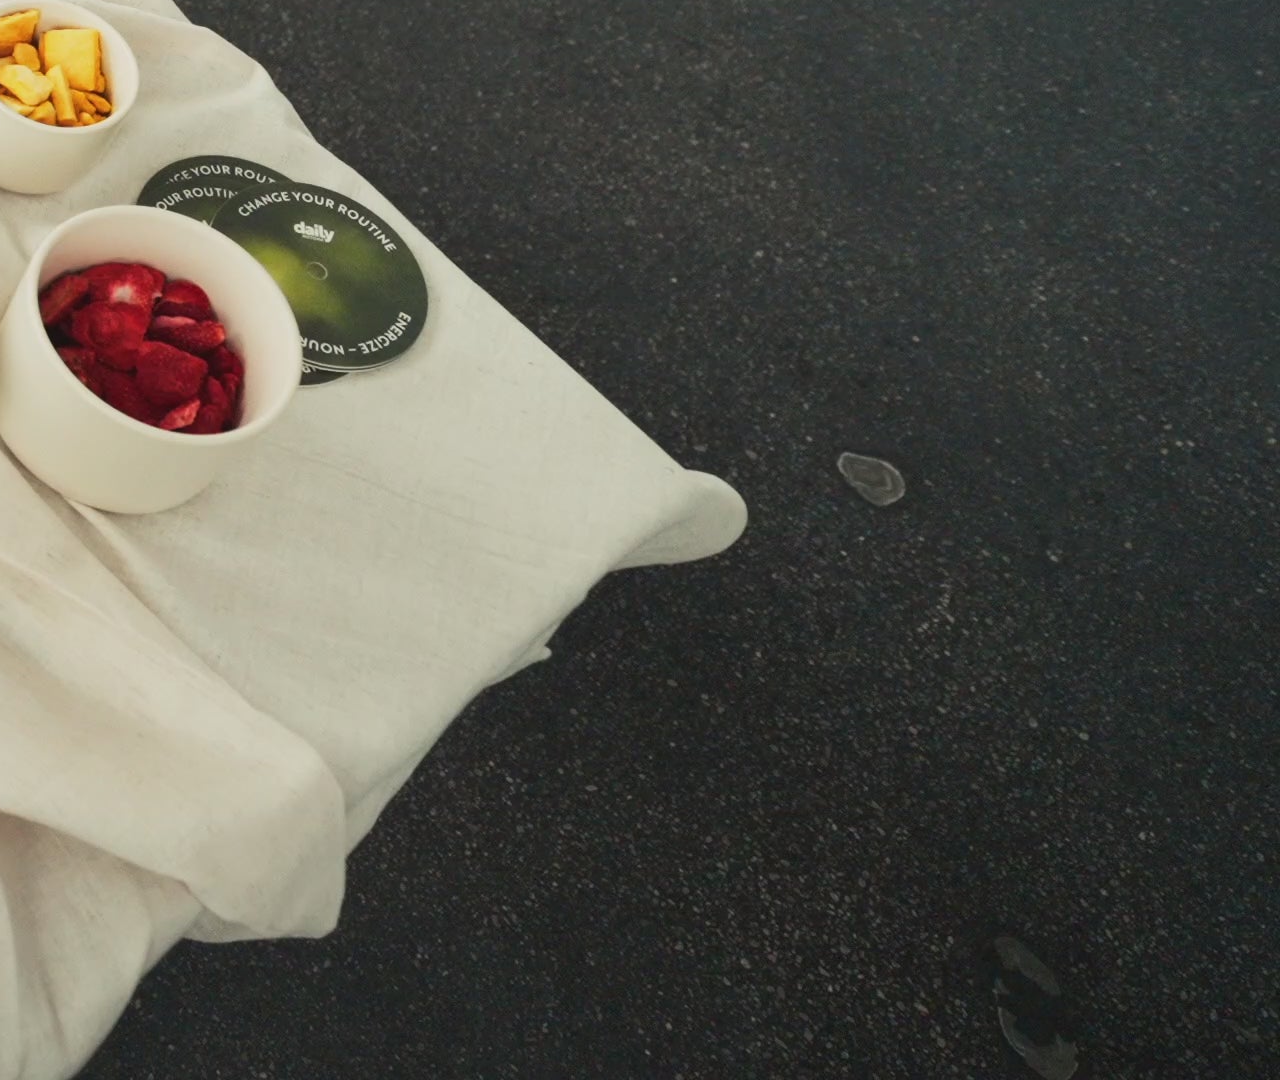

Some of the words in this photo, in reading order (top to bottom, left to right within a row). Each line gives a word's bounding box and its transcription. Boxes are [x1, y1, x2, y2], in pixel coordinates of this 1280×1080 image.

[191, 164, 231, 177] YOUR
[155, 192, 183, 211] OUR
[238, 191, 290, 217] CHANGE
[292, 192, 334, 209] YOUR
[337, 204, 397, 252] ROUTINE
[293, 221, 335, 243] daily
[358, 312, 412, 354] ENERGIZE
